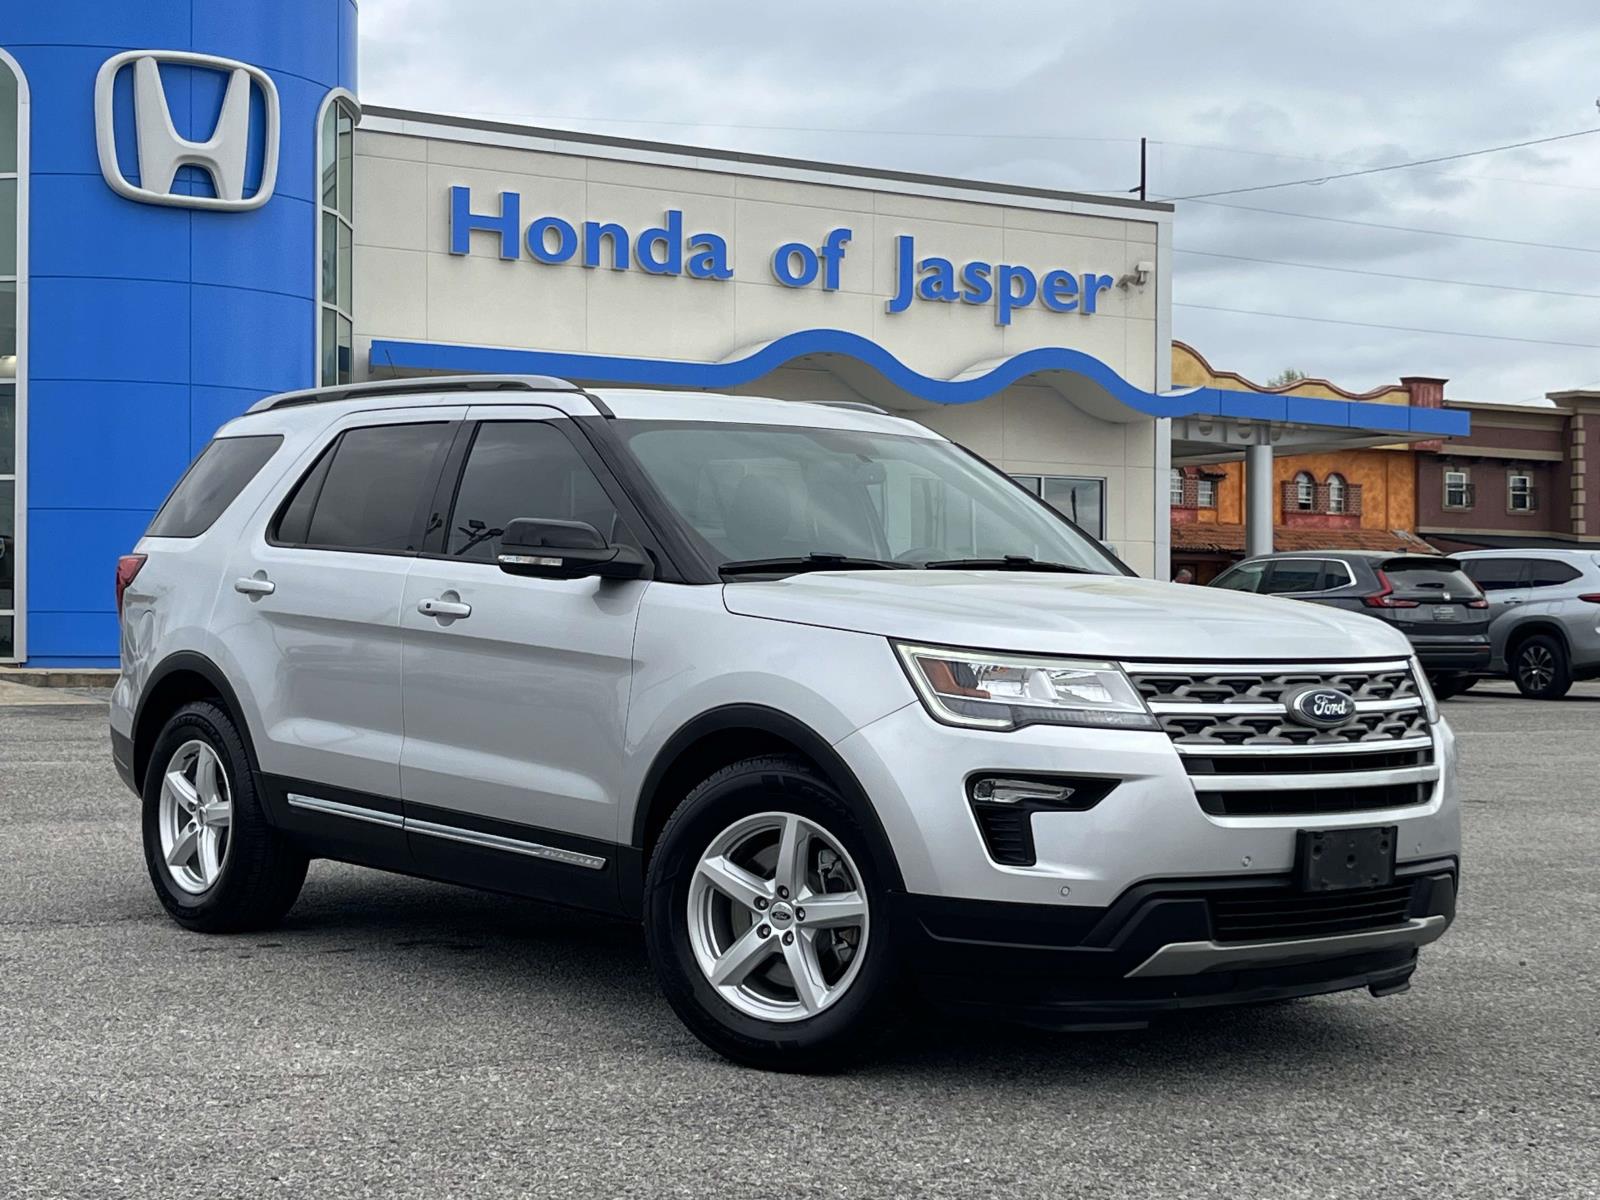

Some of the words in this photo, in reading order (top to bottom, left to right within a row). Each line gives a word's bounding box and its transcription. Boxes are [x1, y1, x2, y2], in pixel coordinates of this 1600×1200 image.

[450, 185, 734, 281] Honda
[772, 227, 854, 292] of
[886, 234, 1115, 327] Jasper
[1313, 694, 1347, 715] Ford
